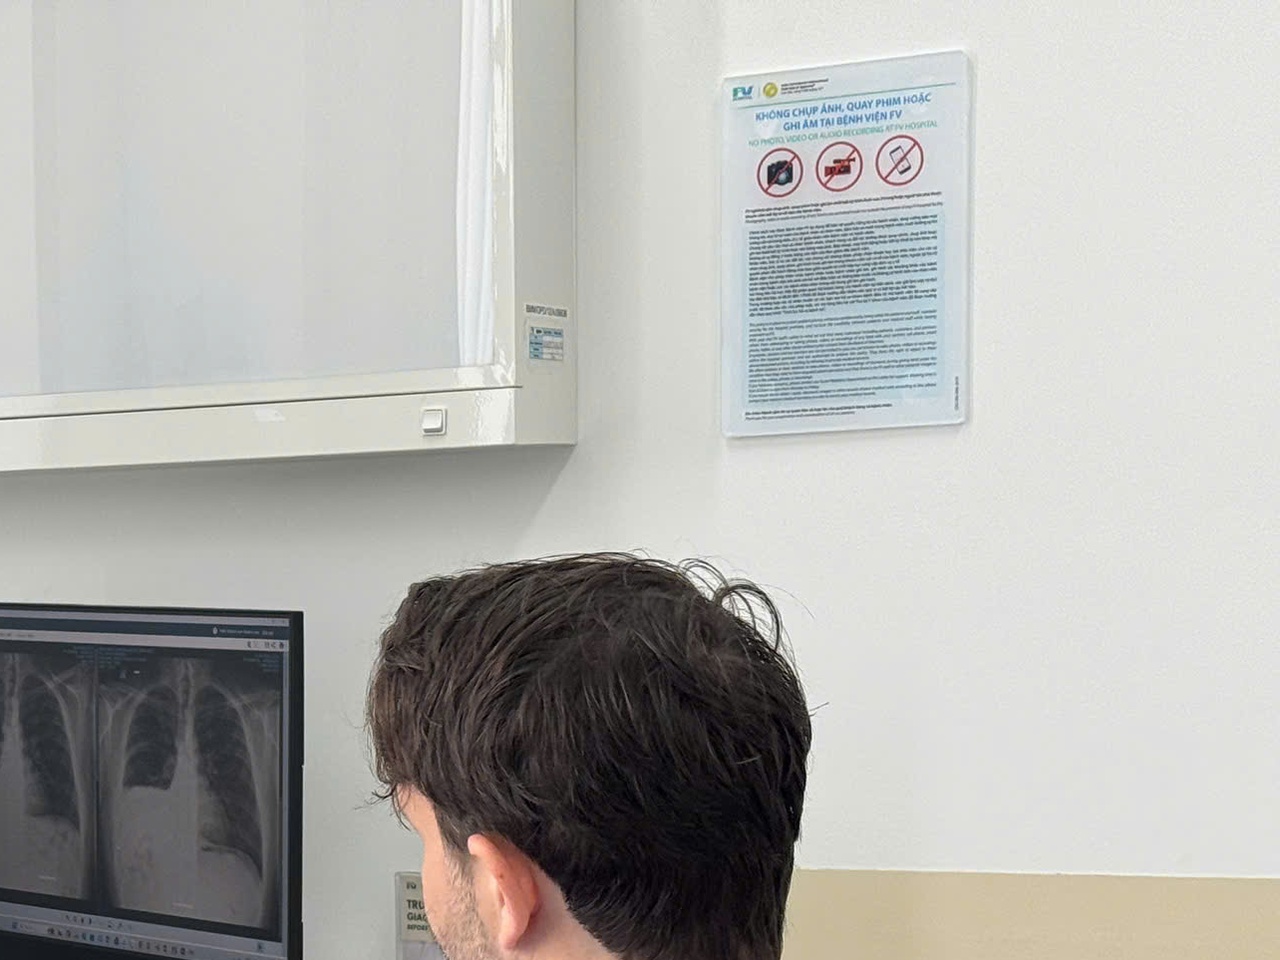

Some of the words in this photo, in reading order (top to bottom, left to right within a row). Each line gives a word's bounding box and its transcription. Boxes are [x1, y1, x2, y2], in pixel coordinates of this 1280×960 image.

[755, 108, 790, 121] KHÔNG
[792, 106, 819, 118] CHỤP
[847, 100, 873, 111] QUAY
[875, 97, 900, 107] PHIM
[903, 92, 931, 104] HOẶC
[783, 121, 800, 131] GHI
[803, 118, 818, 129] ÂM
[821, 117, 834, 129] TẠI
[837, 114, 863, 127] BỆNH
[864, 111, 887, 123] VIỆN
[889, 110, 902, 120] FV
[786, 133, 806, 143] VIDEO
[844, 126, 884, 137] RECORDING
[905, 120, 938, 131] HOSPITAL
